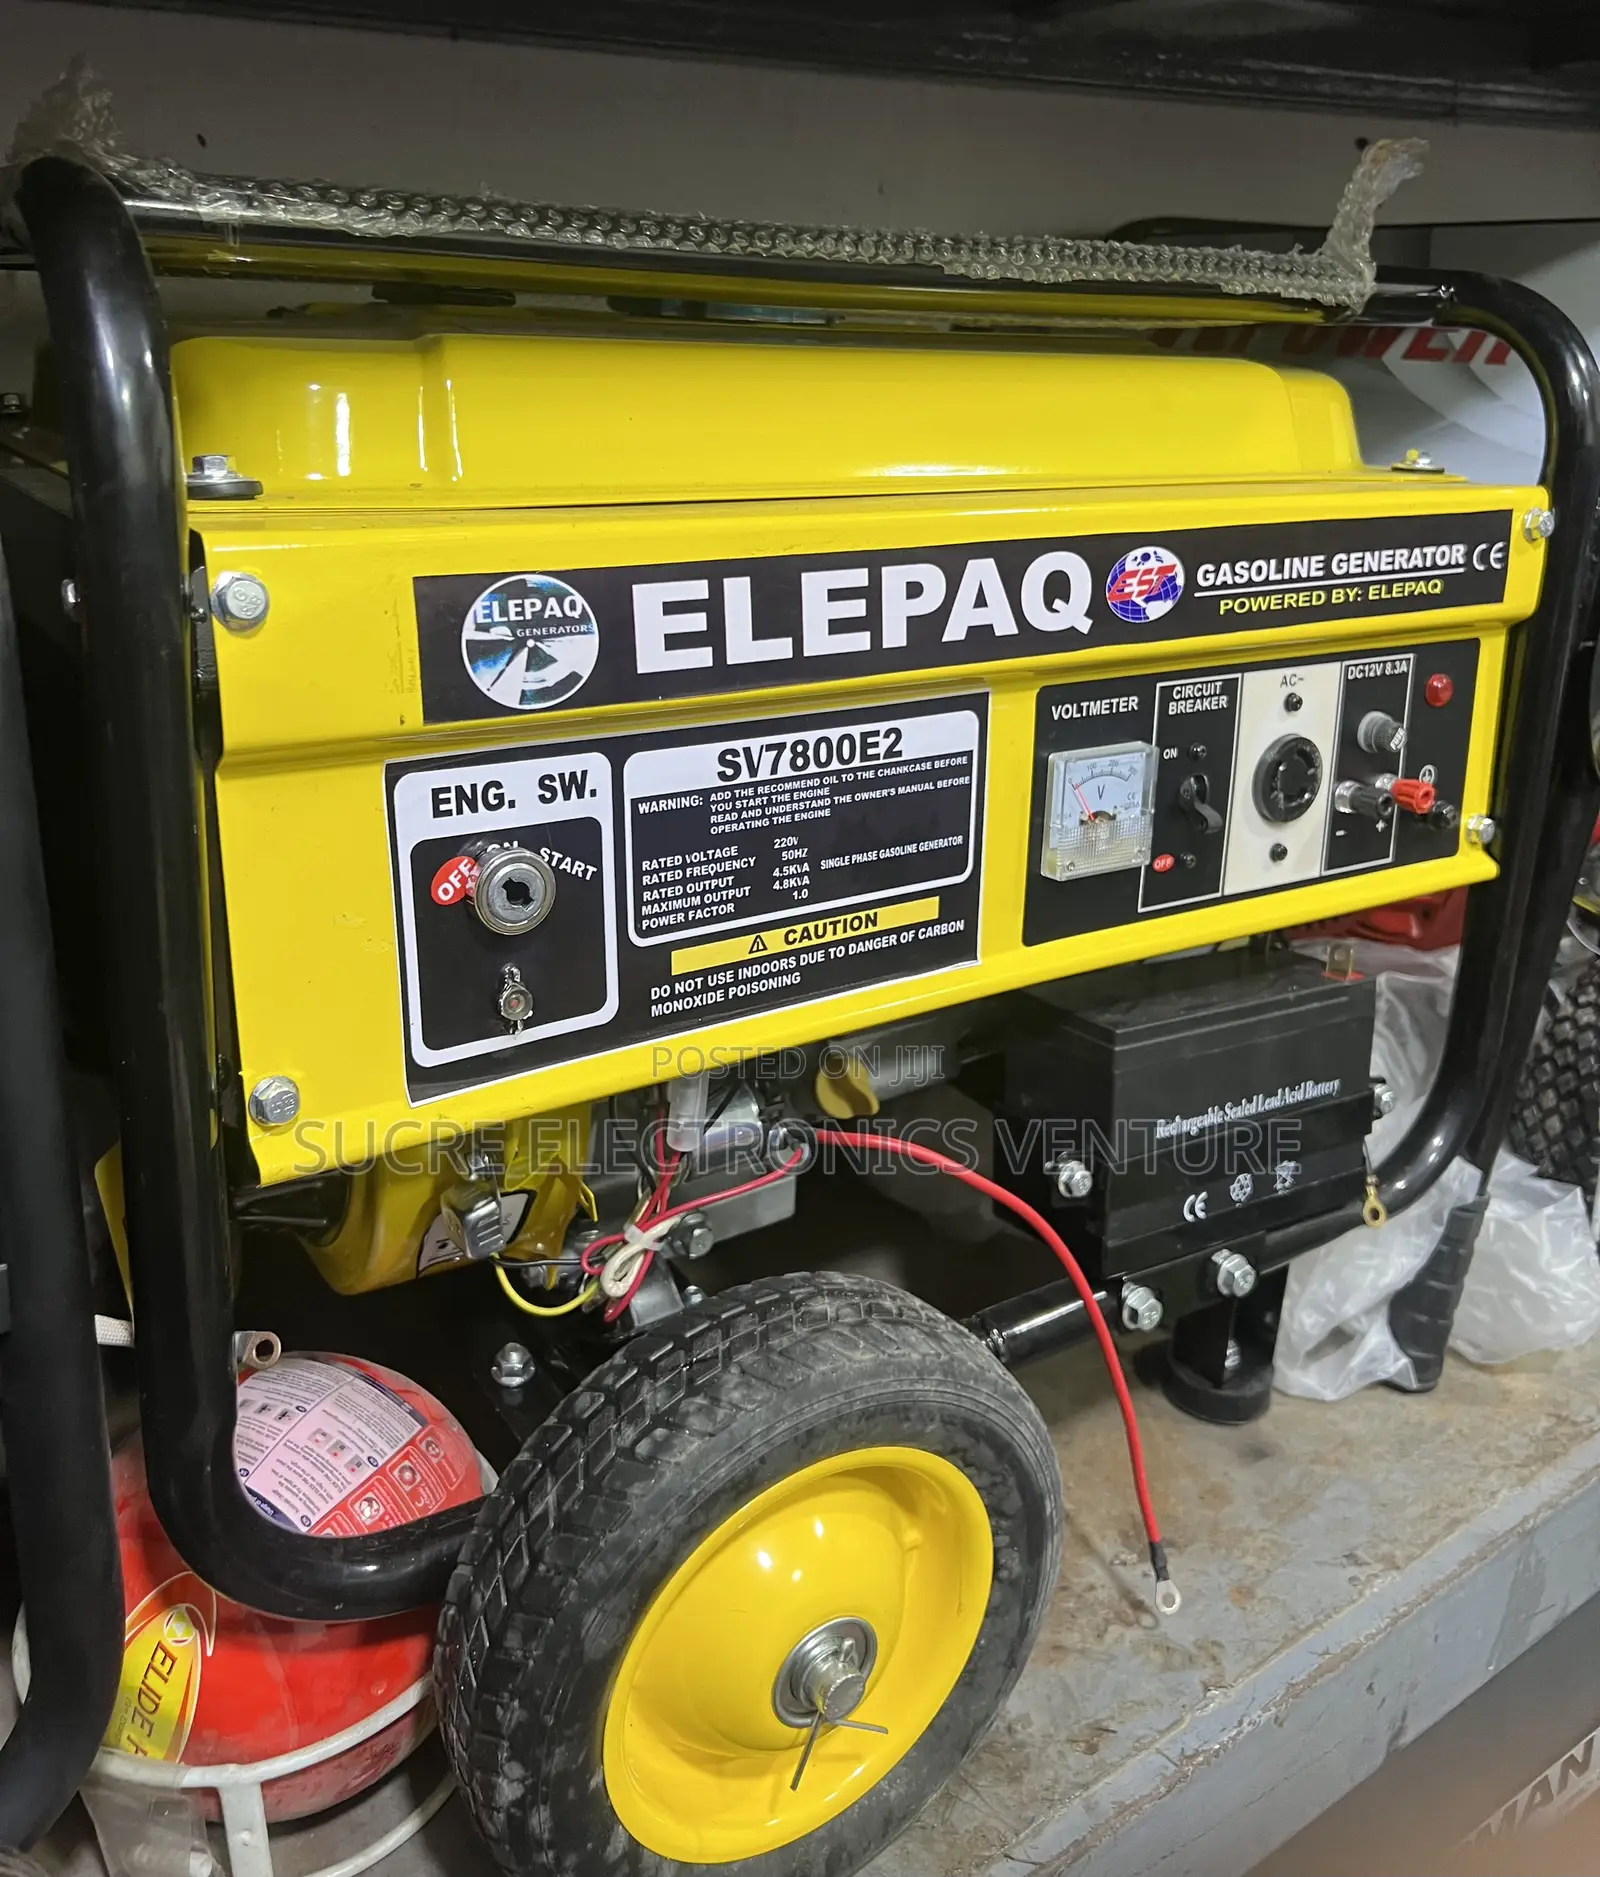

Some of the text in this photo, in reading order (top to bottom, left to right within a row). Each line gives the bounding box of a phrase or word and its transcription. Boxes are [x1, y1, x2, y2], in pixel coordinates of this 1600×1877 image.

[1197, 542, 1467, 588] GASOLINE GENERATOR
[475, 596, 582, 623] ELEPAQ
[631, 550, 1092, 675] ELEPAQ
[1219, 578, 1443, 615] POWERED BY: ELEPAQ
[516, 624, 594, 637] GENERATORS
[1348, 660, 1408, 680] DC12V 8.3A
[1052, 696, 1139, 721] VOLTMETER
[1168, 696, 1228, 715] BREAKER
[1173, 681, 1222, 700] CIRCUIT
[717, 727, 903, 783] SV7800E2
[1163, 748, 1177, 759] ON
[431, 769, 598, 819] ENG. SW.
[638, 756, 968, 815] WARNING: ADD THE RECOMMEND OIL TO THE CHANKCASE BEFORE
[710, 787, 830, 813] YOU START THE ENGINE
[710, 776, 970, 824] READ AND UNDERSTAND THE OWNER'S MANUAL BEFORE
[710, 809, 831, 835] OPERATING THE ENGINE
[539, 847, 598, 881] START
[642, 836, 799, 871] RATED VOLTAGE 220V
[642, 848, 808, 886] RATED FREQUENCY 50HZ
[820, 835, 963, 870] SINGLE PHASE GASOLINE GENERATOR
[1155, 857, 1172, 869] OFF
[437, 858, 472, 901] OFF
[641, 875, 810, 916] MAXIMUM OUTPUT 4.8KVA
[643, 862, 810, 902] RATED OUTPUT 4.5KVA
[642, 888, 809, 930] POWER FACTOR 1.0
[783, 912, 878, 946] CAUTION
[650, 919, 965, 1002] DO NOT USE INDOORS DUE TO DANGER OF CARBON
[650, 971, 801, 1018] MONOXIDE POISONING
[1156, 1105, 1224, 1139] Rechargeable
[1224, 1095, 1257, 1122] Sealed
[1305, 1078, 1341, 1101] Battery
[131, 1640, 178, 1739] ELIDE
